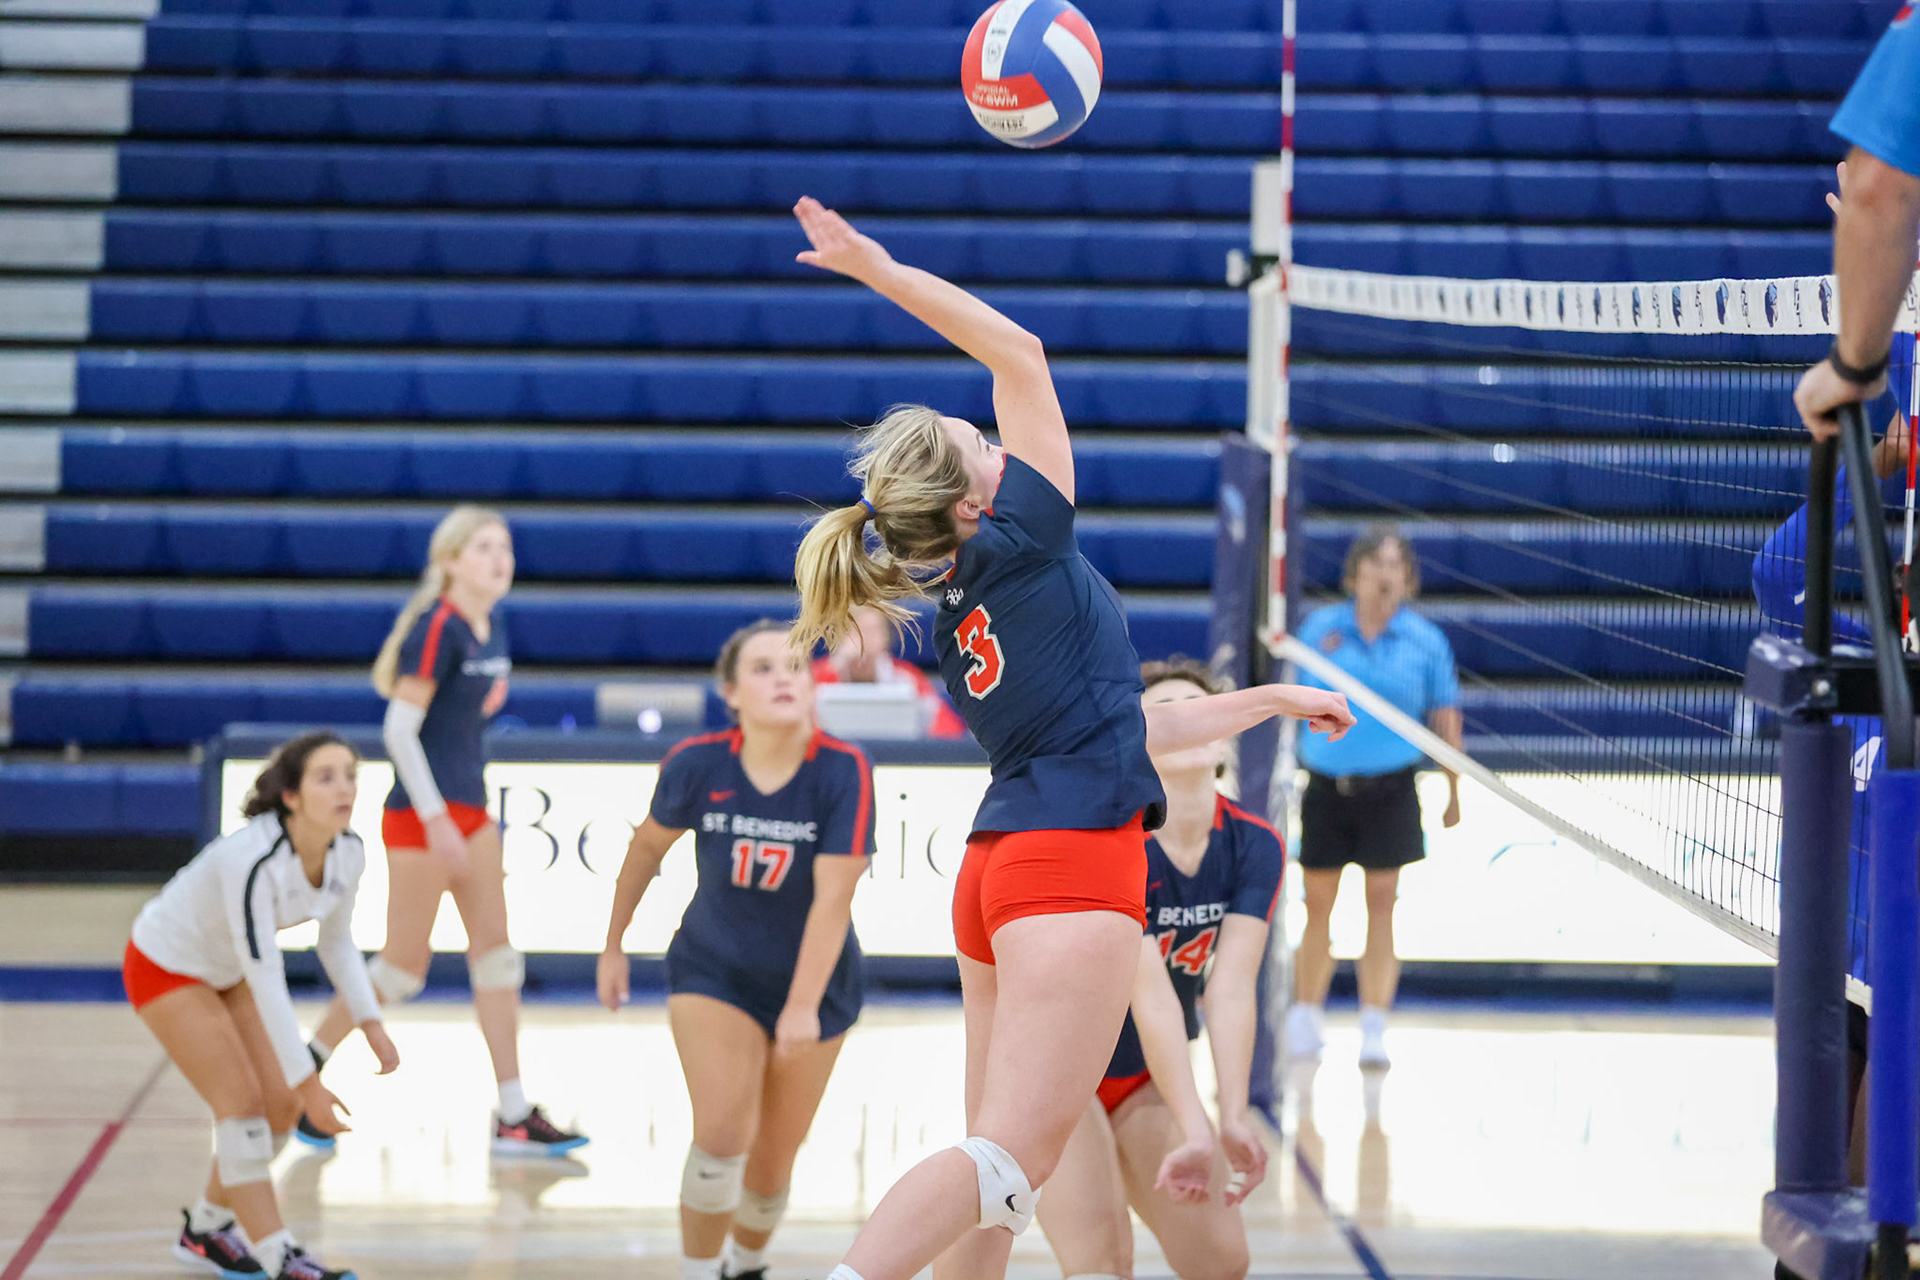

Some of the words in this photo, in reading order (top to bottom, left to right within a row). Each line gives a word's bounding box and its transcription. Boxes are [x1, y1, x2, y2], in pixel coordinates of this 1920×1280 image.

[953, 603, 1005, 701] 3
[1850, 735, 1884, 792] 4
[702, 812, 728, 833] ST.
[732, 815, 818, 842] BENEDIC
[732, 838, 795, 892] 17
[1157, 902, 1228, 927] BENED
[1157, 926, 1218, 976] 14
